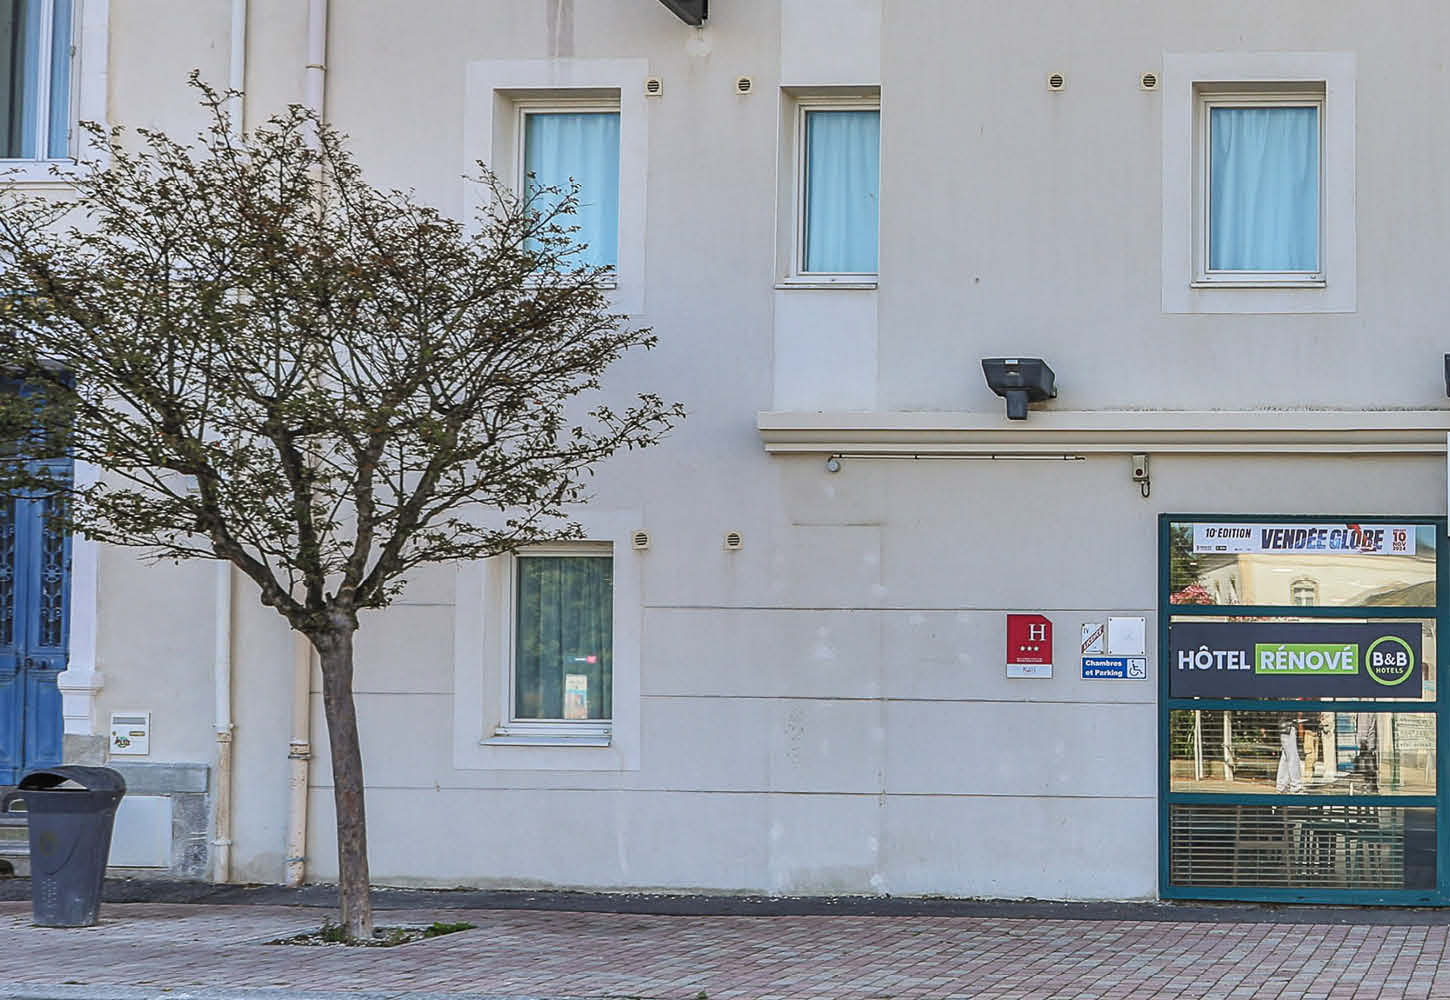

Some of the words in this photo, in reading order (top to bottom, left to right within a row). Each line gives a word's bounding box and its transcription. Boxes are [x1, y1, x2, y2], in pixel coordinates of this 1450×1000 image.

[1261, 526, 1328, 550] VENDÉE
[1329, 527, 1385, 550] GLOBE
[1392, 531, 1407, 542] 10
[1028, 623, 1047, 641] H
[1177, 645, 1251, 671] HÔTEL
[1259, 645, 1354, 671] RÉNOVÉ
[1373, 651, 1408, 666] B&B
[1094, 669, 1123, 678] Parking
